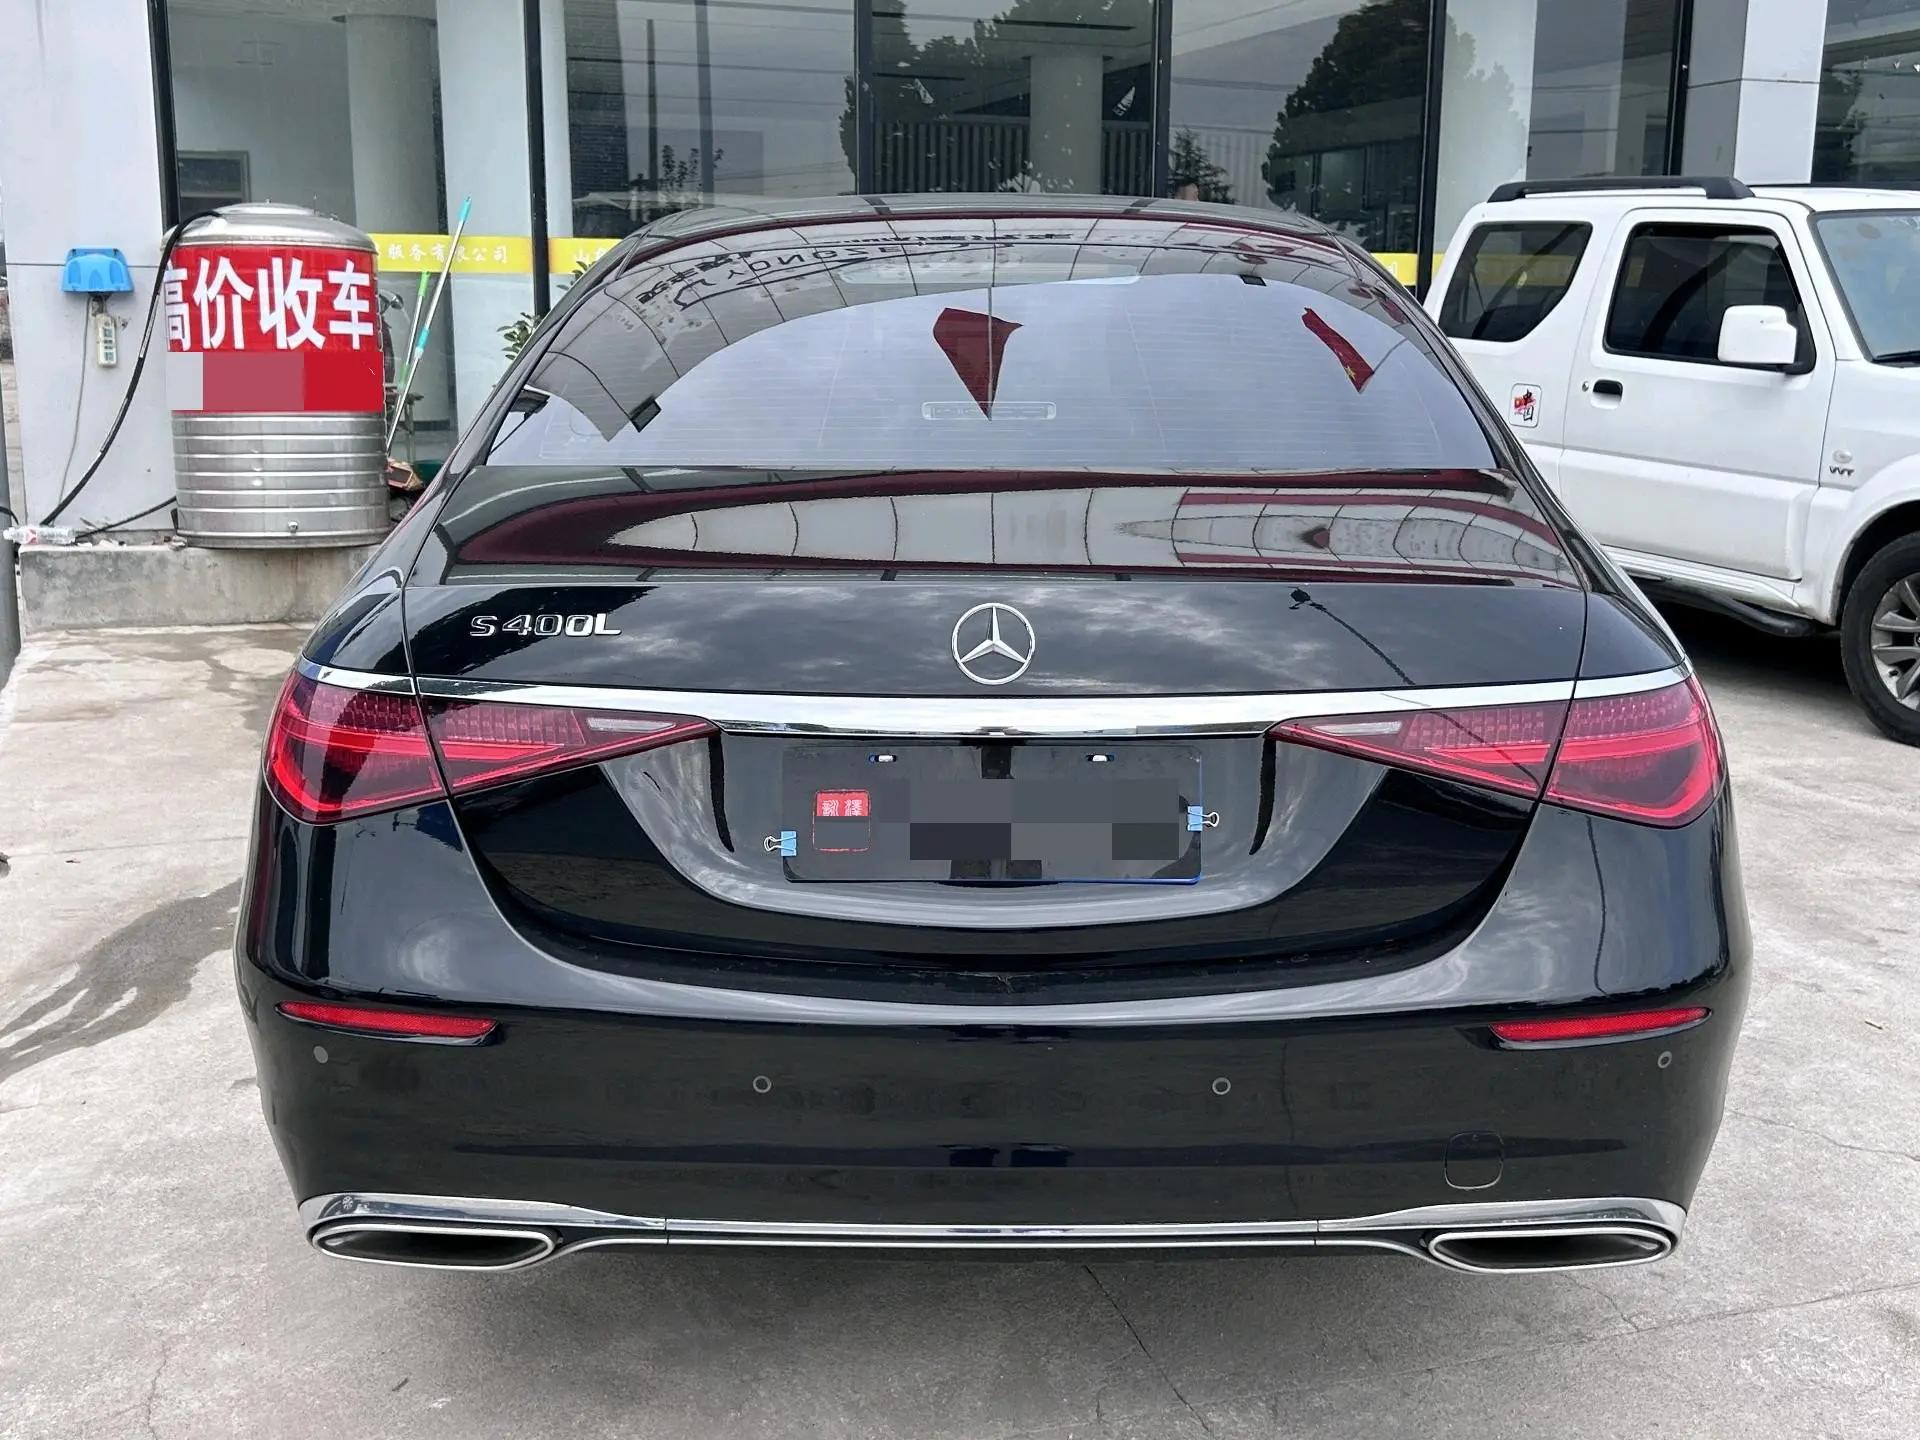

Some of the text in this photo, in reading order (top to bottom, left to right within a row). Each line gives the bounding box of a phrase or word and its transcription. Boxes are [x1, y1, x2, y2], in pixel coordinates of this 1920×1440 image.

[377, 243, 508, 264] 服务有限公司
[163, 255, 374, 351] 高价收车
